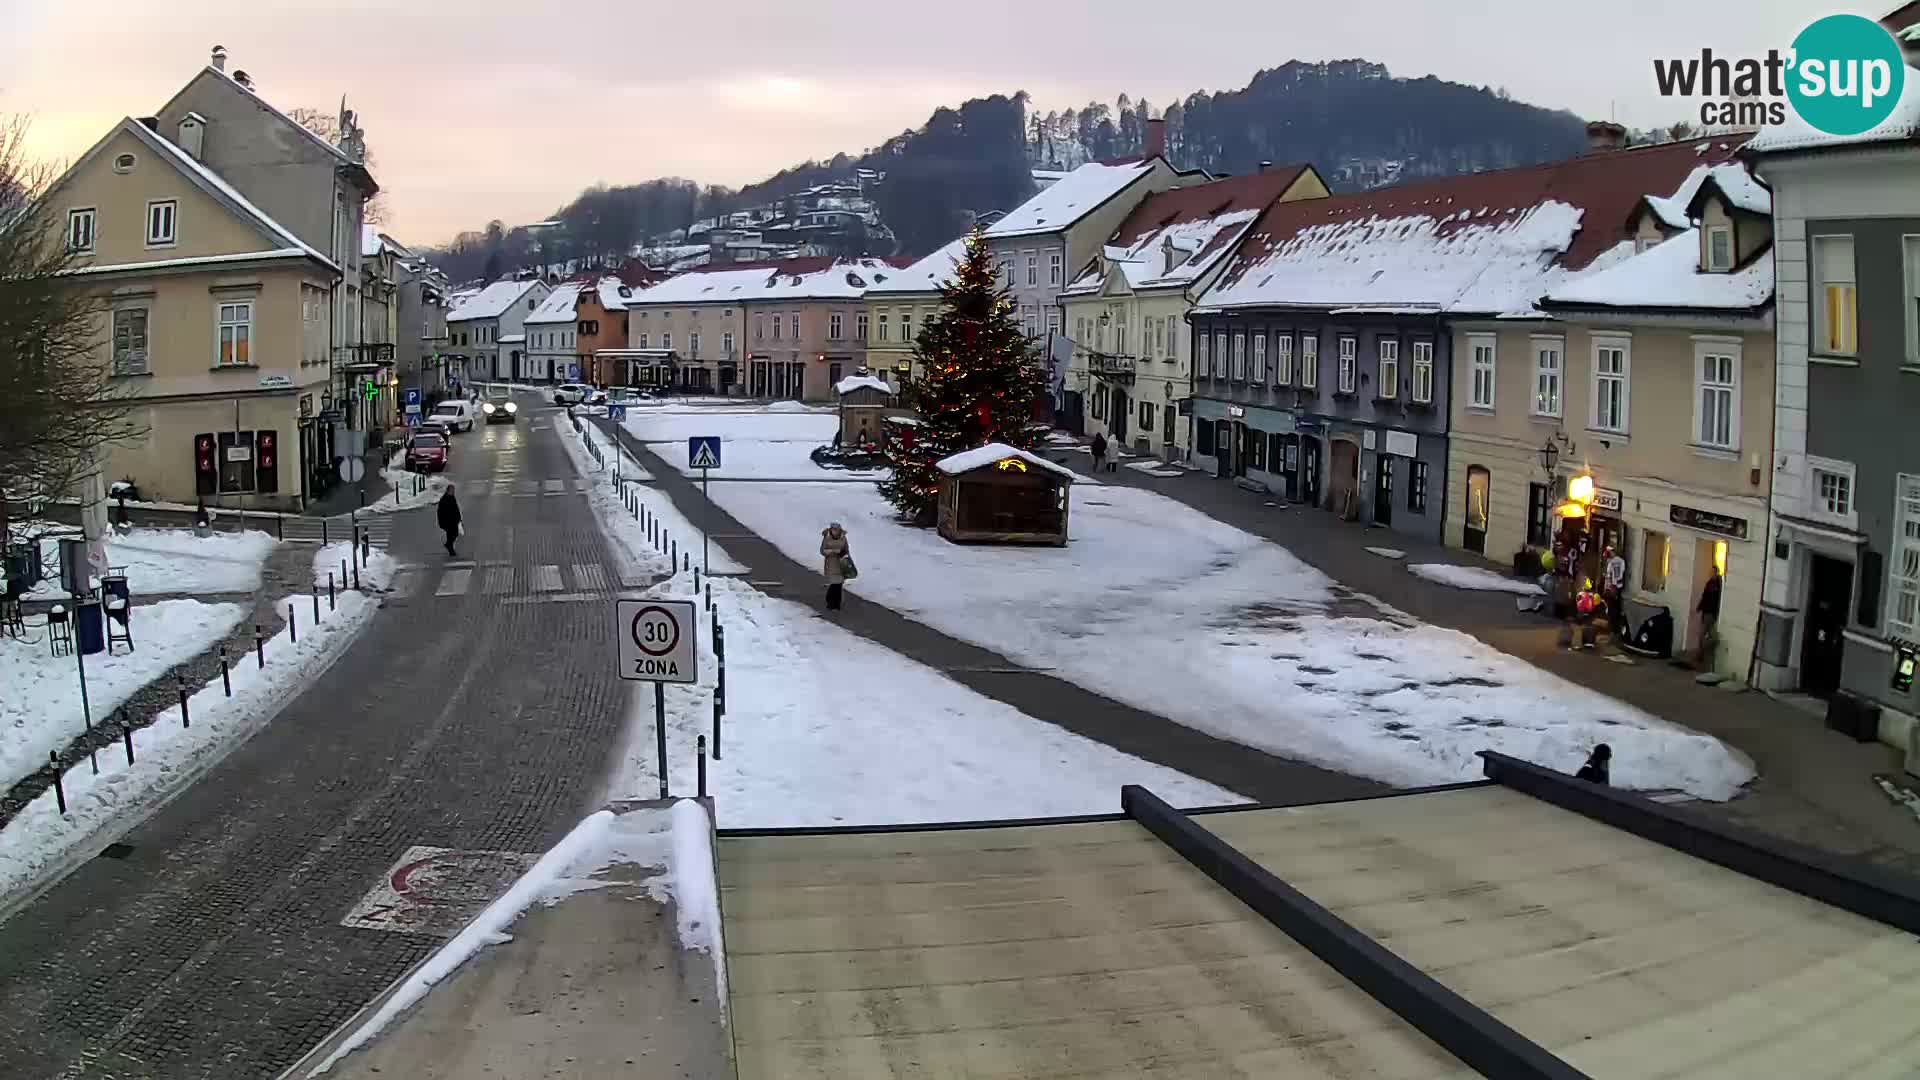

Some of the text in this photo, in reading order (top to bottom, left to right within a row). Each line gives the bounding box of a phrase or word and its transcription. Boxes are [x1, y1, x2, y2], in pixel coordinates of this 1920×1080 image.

[409, 391, 417, 402] P
[645, 622, 668, 642] 30
[634, 659, 679, 675] ZONA
